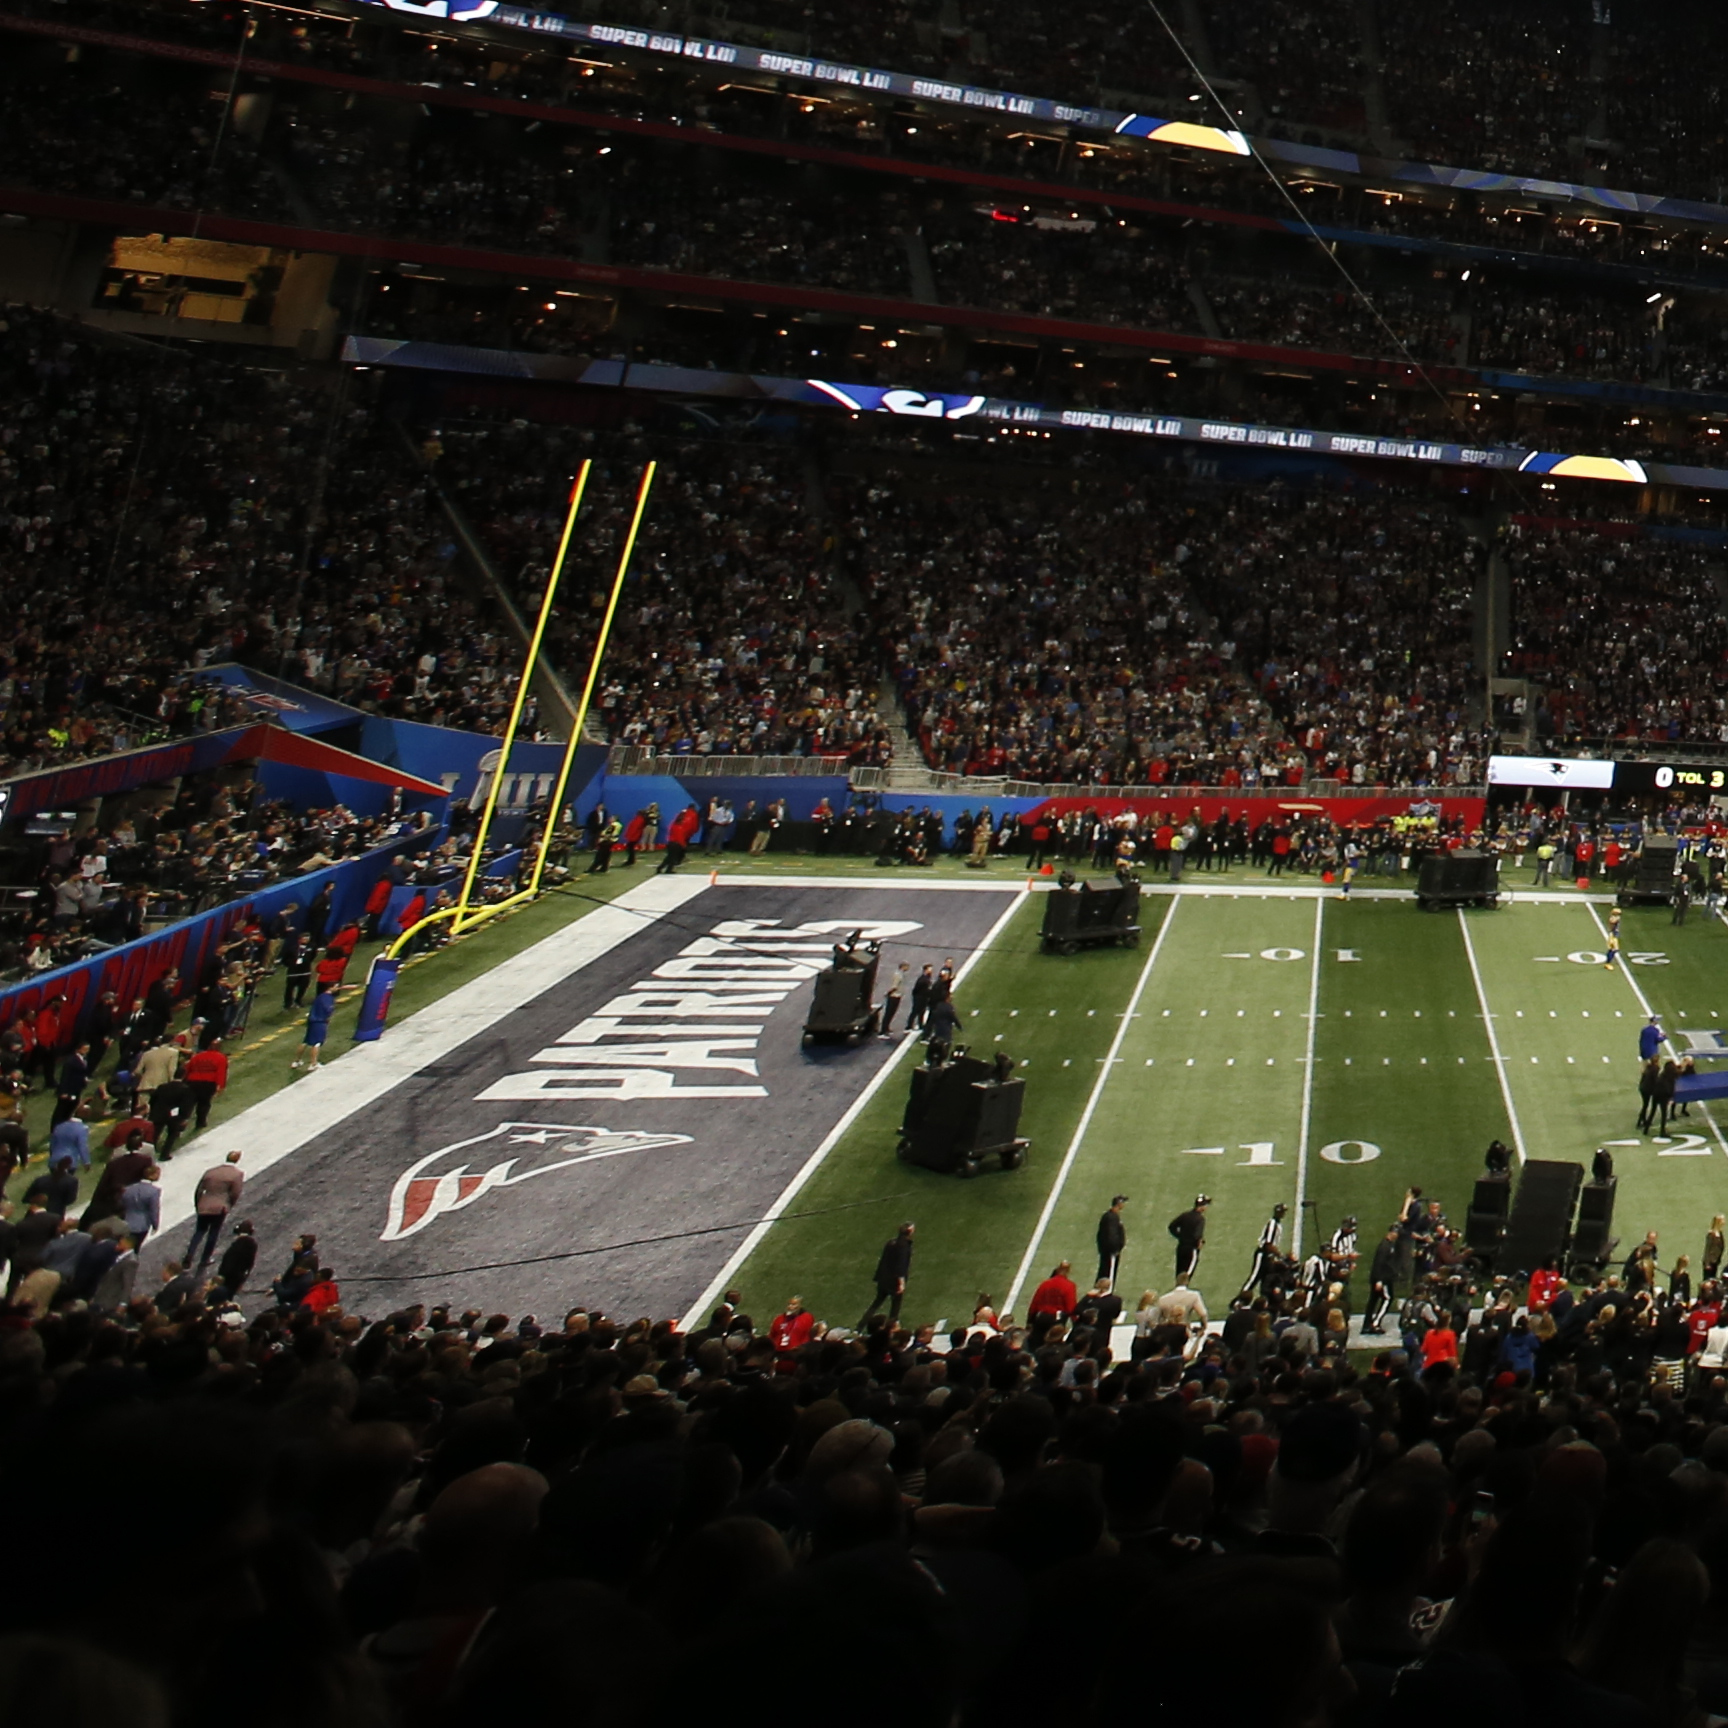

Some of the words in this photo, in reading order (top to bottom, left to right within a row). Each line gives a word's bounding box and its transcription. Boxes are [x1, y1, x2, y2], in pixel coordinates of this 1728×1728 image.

[588, 24, 648, 47] SUPER
[706, 42, 737, 63] LIII
[758, 53, 812, 77] SUPER
[817, 65, 860, 85] BOWL
[863, 71, 891, 90] LIII
[911, 80, 962, 103] SUPER
[964, 89, 1005, 110] BOWL
[1007, 95, 1035, 115] LIII
[1060, 410, 1109, 430] SUPER
[1111, 415, 1153, 434] BOWL
[1155, 419, 1181, 436] LIII
[1200, 424, 1246, 443] SUPER
[1247, 428, 1287, 447] BOWL
[1288, 431, 1313, 449] LIII
[1330, 436, 1376, 455] SUPER
[1378, 440, 1416, 459] BOWL
[1418, 443, 1442, 461] LIII
[1654, 766, 1675, 788] 0
[1676, 772, 1705, 785] TOL
[1709, 770, 1725, 788] 3
[1260, 947, 1362, 962] 10
[473, 918, 924, 1101] PATRIOTS
[1234, 1140, 1382, 1166] 10
